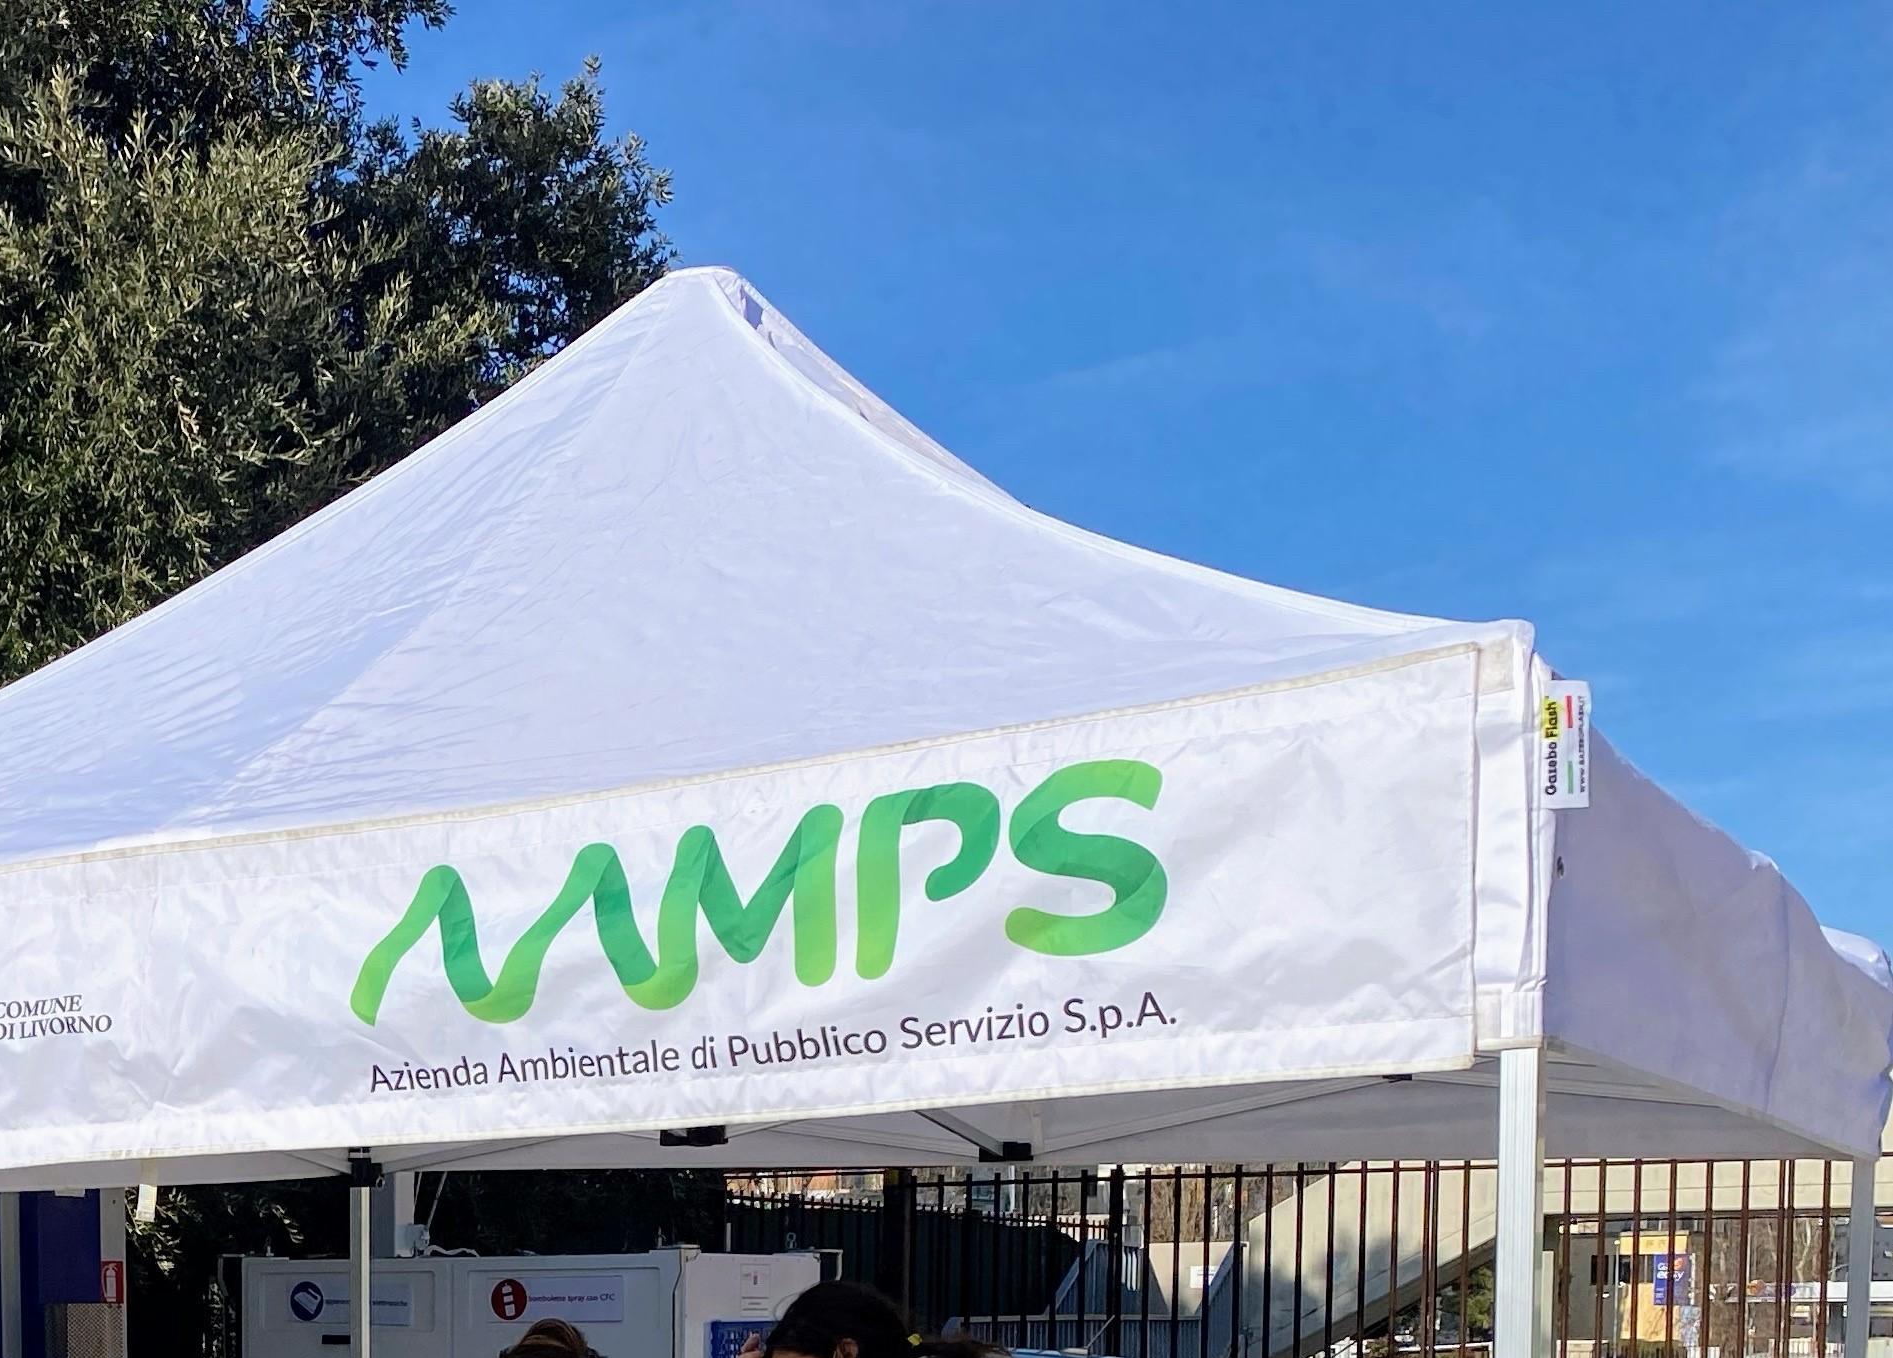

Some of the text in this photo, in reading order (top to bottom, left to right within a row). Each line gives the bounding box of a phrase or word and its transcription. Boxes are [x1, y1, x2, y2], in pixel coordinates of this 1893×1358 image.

[19, 1014, 112, 1039] LIVORNO
[368, 990, 1179, 1094] Azienda Ambientale di Pubblico Servizio S.p.A.
